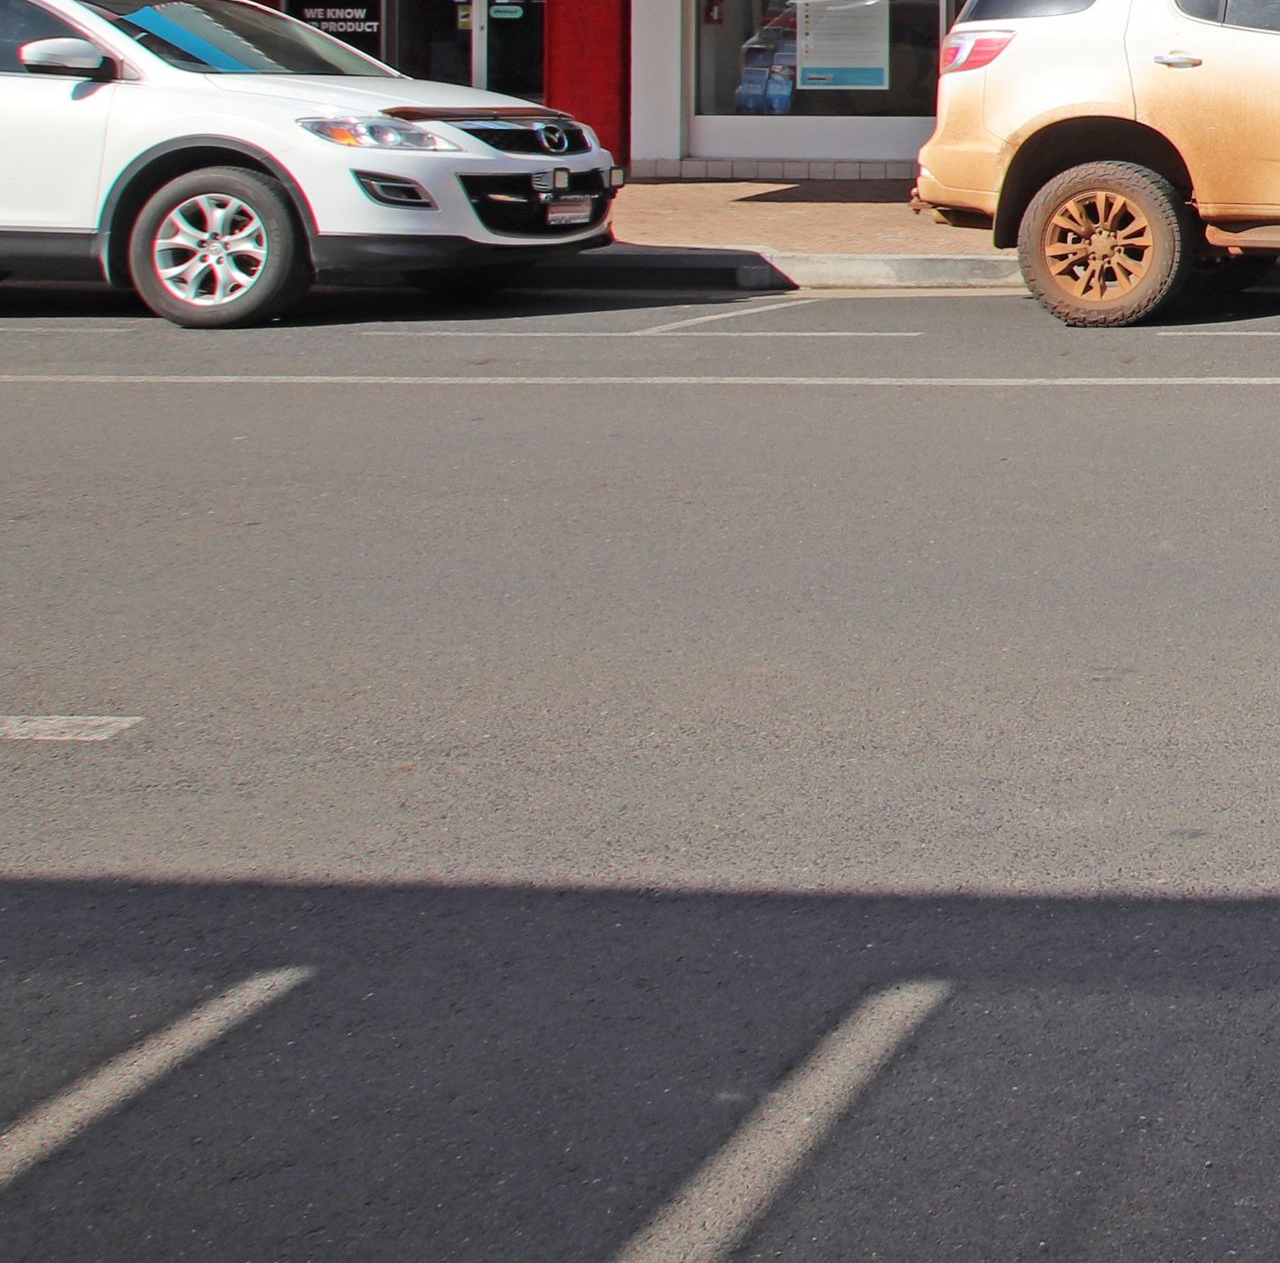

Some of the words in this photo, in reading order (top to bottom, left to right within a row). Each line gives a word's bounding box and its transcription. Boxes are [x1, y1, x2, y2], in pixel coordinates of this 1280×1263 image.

[304, 8, 324, 19] WE
[326, 8, 367, 19] KNOW
[321, 22, 379, 33] PRODUCT
